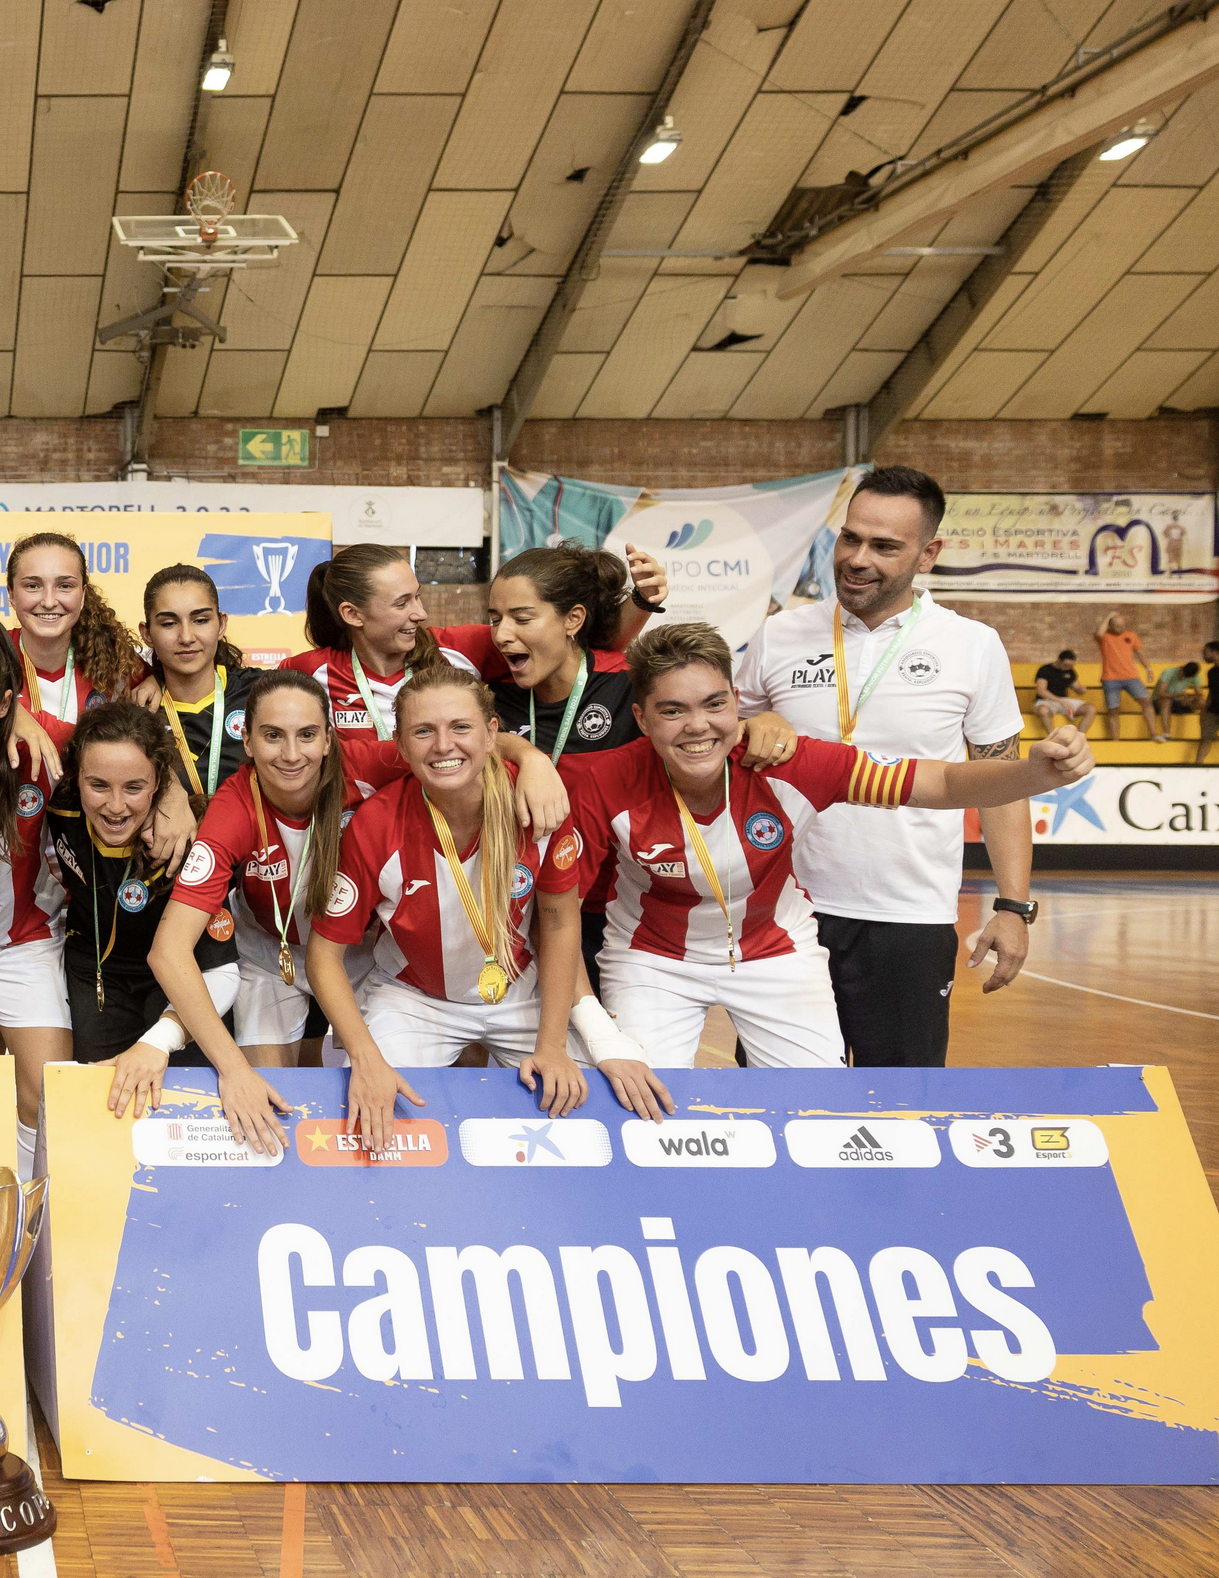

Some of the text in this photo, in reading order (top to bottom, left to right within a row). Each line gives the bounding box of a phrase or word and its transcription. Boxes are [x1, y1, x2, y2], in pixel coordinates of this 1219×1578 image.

[992, 526, 1081, 538] ESPORTIVA
[993, 538, 1081, 550] MARES
[706, 559, 751, 577] CMI
[697, 583, 740, 592] INTEGRAL
[251, 653, 287, 662] ESTRELLA
[792, 669, 836, 684] PLAY
[336, 711, 367, 724] PLAY
[564, 710, 574, 727] SALA
[569, 695, 579, 710] 2022
[1118, 780, 1219, 832] Cai
[248, 860, 281, 877] PLAY
[187, 1133, 200, 1142] de
[658, 1133, 730, 1157] wala
[988, 1127, 1016, 1159] 3
[185, 1150, 250, 1163] esportcat
[369, 1151, 402, 1161] DAMM
[838, 1146, 894, 1162] adidas
[257, 1216, 1058, 1409] Campiones
